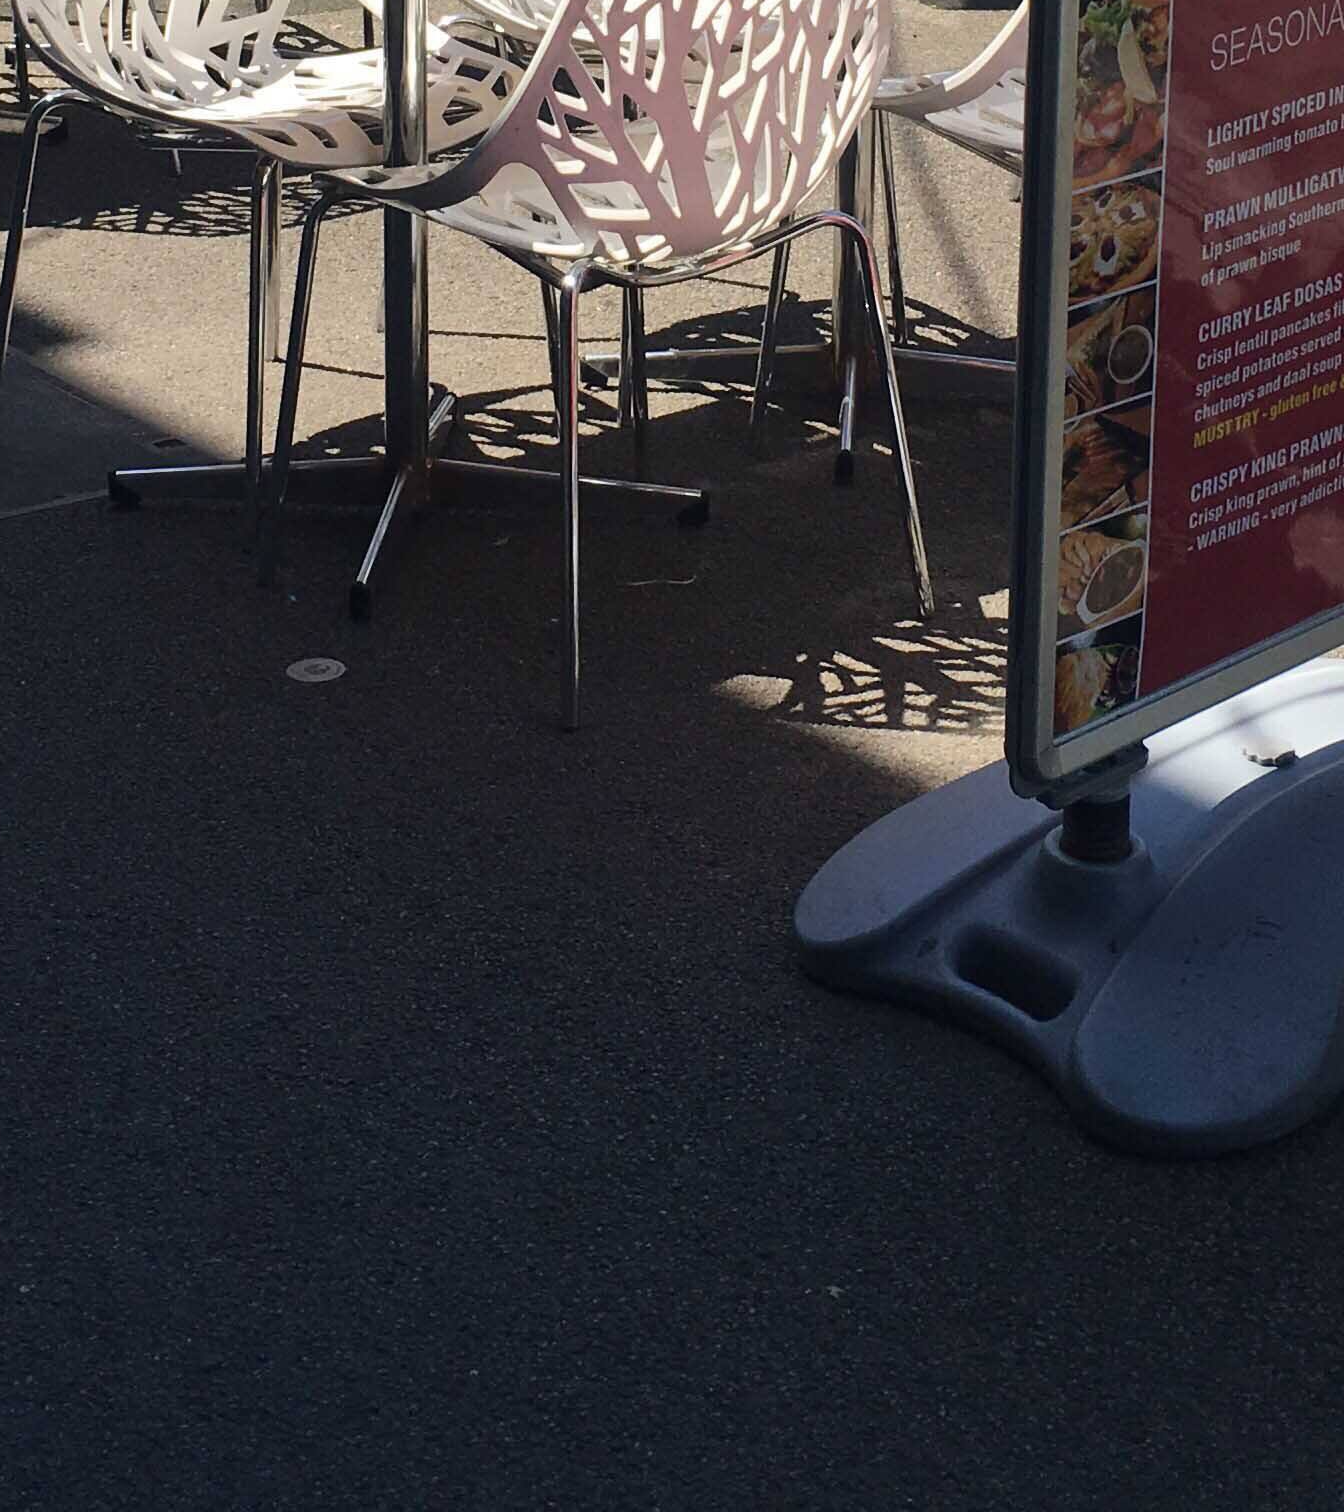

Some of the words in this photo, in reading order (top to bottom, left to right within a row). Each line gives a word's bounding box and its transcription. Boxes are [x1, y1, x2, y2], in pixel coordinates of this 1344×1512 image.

[1206, 151, 1236, 176] Soul
[1237, 133, 1292, 166] warming
[1294, 117, 1339, 145] tomato
[1207, 109, 1270, 148] LIGHTLY
[1271, 90, 1326, 127] SPICED
[1201, 240, 1223, 262] Lip
[1224, 218, 1287, 254] smacking
[1288, 198, 1344, 230] Southern
[1203, 195, 1261, 233] PRAWN
[1200, 268, 1216, 288] of
[1216, 256, 1258, 286] prawn
[1259, 239, 1302, 266] bisque
[1198, 306, 1253, 343] CURRY
[1254, 292, 1292, 322] LEAF
[1293, 272, 1344, 308] DOSAS
[1195, 372, 1240, 398] spiced
[1241, 346, 1299, 380] potatoes
[1299, 328, 1342, 354] served
[1196, 348, 1233, 371] Crisp
[1234, 335, 1269, 358] lentil
[1270, 309, 1332, 347] pancakes
[1193, 419, 1233, 449] MUST
[1234, 407, 1260, 433] TRY
[1269, 390, 1310, 421] gluten
[1312, 380, 1338, 402] free
[1194, 389, 1256, 424] chutneys
[1256, 377, 1281, 399] and
[1282, 363, 1311, 389] daal
[1312, 352, 1343, 377] soup
[1188, 504, 1224, 530] Crisp
[1225, 490, 1256, 514] king
[1256, 473, 1301, 505] prawn,
[1302, 458, 1328, 482] hint
[1328, 451, 1342, 472] of
[1189, 462, 1249, 503] CRISPY
[1250, 448, 1288, 479] KING
[1196, 511, 1261, 551] WARNING
[1270, 495, 1299, 520] very
